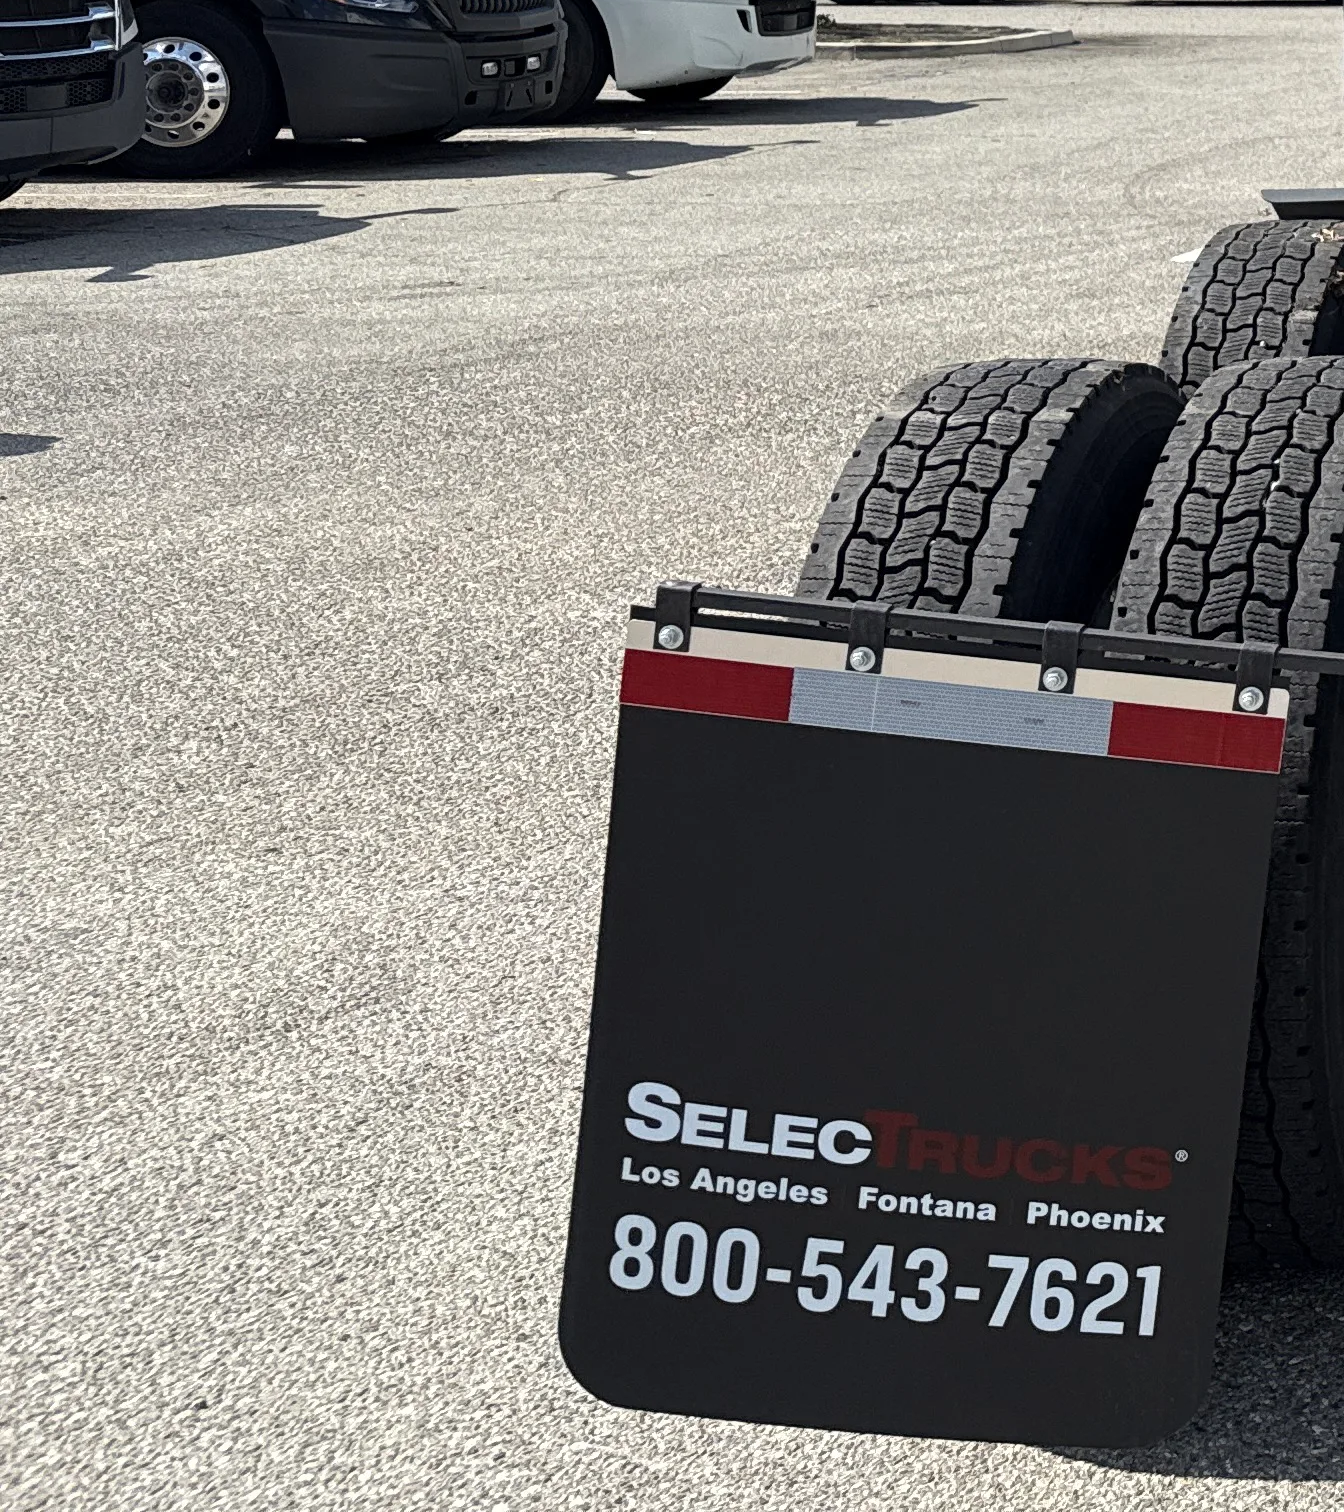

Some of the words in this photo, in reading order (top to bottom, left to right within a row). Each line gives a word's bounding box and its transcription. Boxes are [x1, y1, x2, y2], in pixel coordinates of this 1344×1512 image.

[621, 1156, 680, 1187] Los
[689, 1167, 829, 1206] Angeles
[858, 1186, 998, 1222] Fontana
[1026, 1201, 1166, 1234] Phoenix
[609, 1214, 1162, 1337] 800-543-7621
